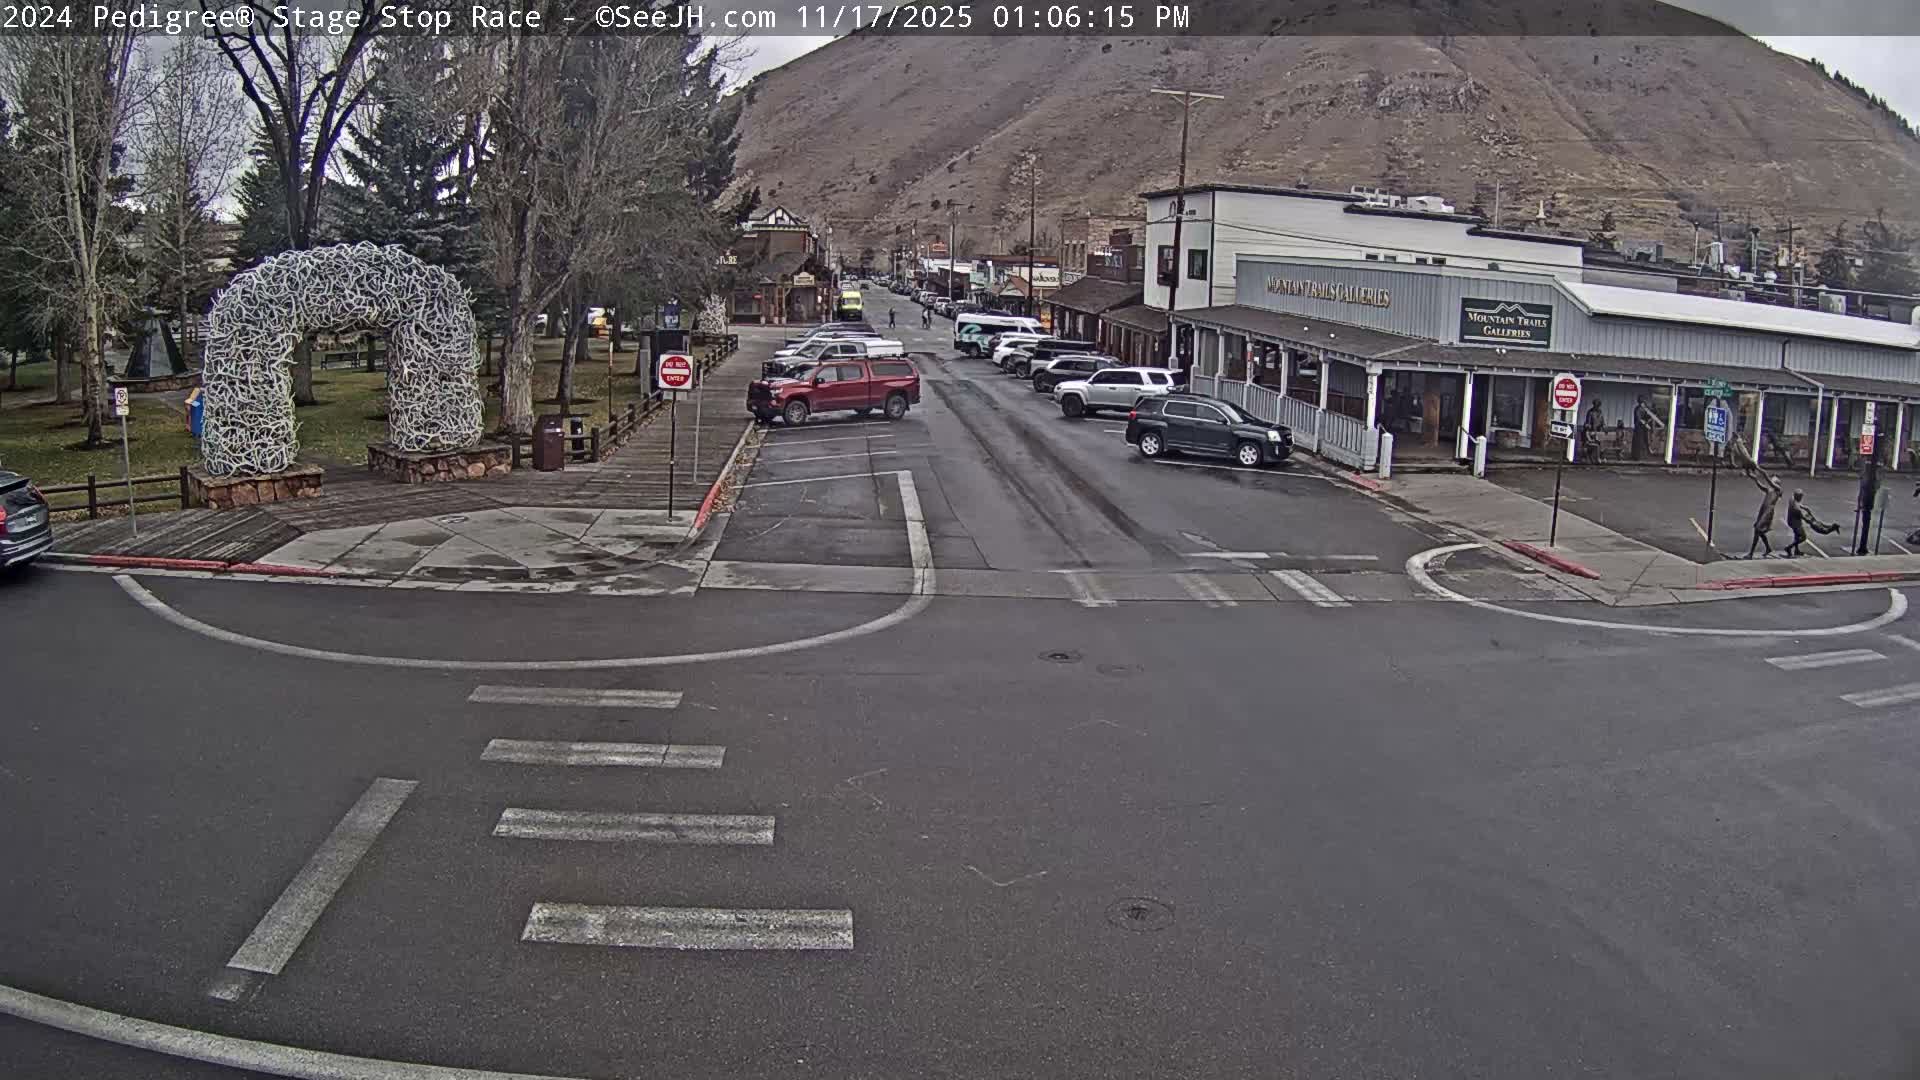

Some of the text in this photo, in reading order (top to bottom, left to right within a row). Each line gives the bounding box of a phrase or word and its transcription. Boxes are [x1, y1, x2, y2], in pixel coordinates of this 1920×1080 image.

[1335, 282, 1391, 308] GALLERIES
[1467, 311, 1547, 328] MOUNTAIN TRAILS
[1483, 325, 1531, 338] GALLERIES
